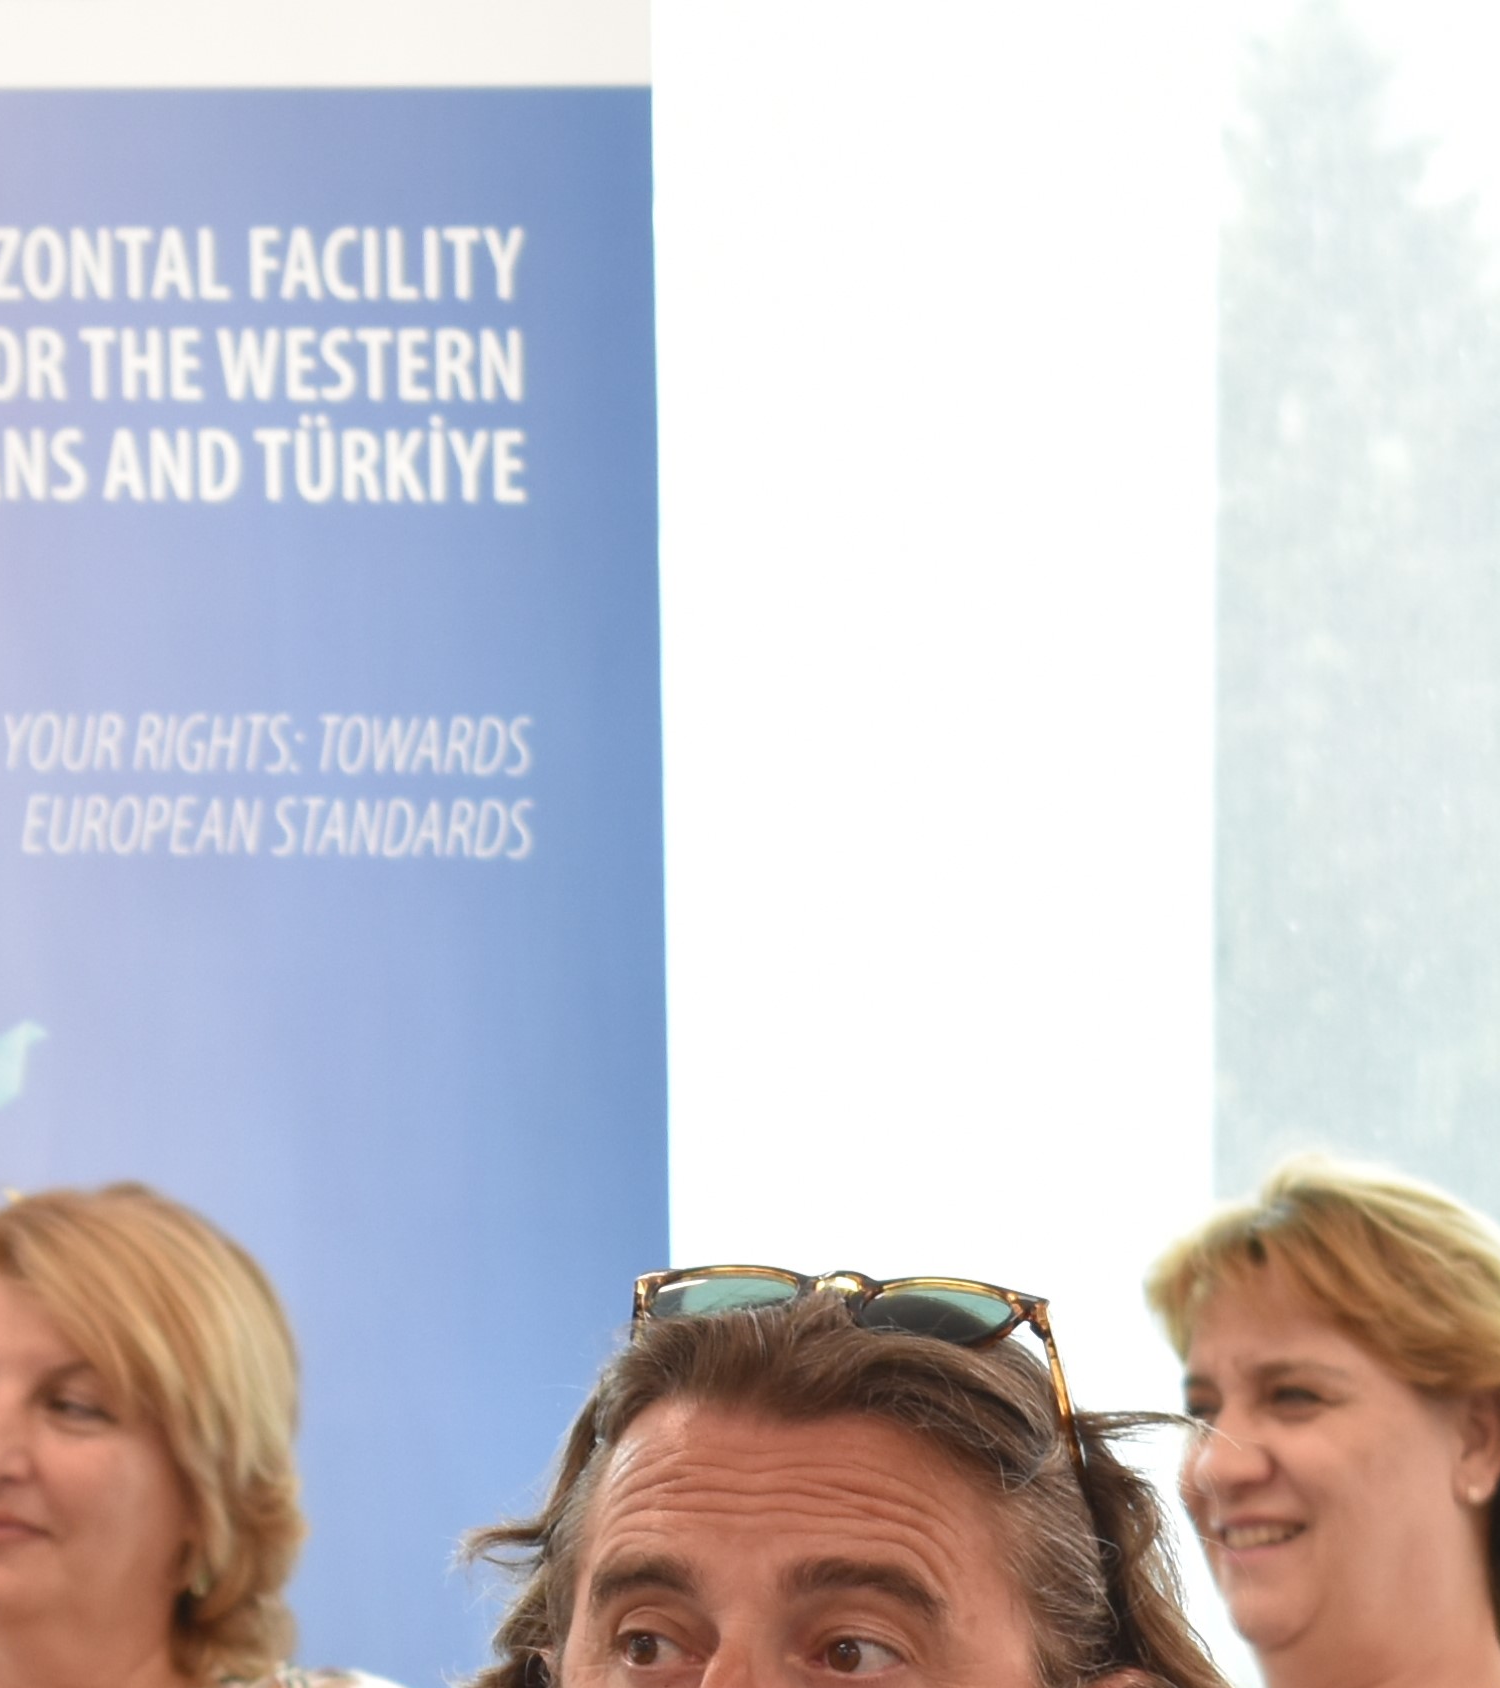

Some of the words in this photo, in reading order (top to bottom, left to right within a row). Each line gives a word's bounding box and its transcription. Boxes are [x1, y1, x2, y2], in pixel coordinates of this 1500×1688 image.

[248, 226, 525, 301] FACILITY
[79, 327, 203, 402] THE
[217, 327, 525, 402] WESTERN
[102, 427, 241, 502] AND
[253, 414, 527, 503] TÜRKİYE
[3, 711, 124, 772] YOUR
[133, 713, 304, 774] RIGHTS:
[318, 714, 533, 777] TOWARDS
[21, 794, 262, 855] EUROPEAN
[272, 796, 533, 859] STANDARDS
